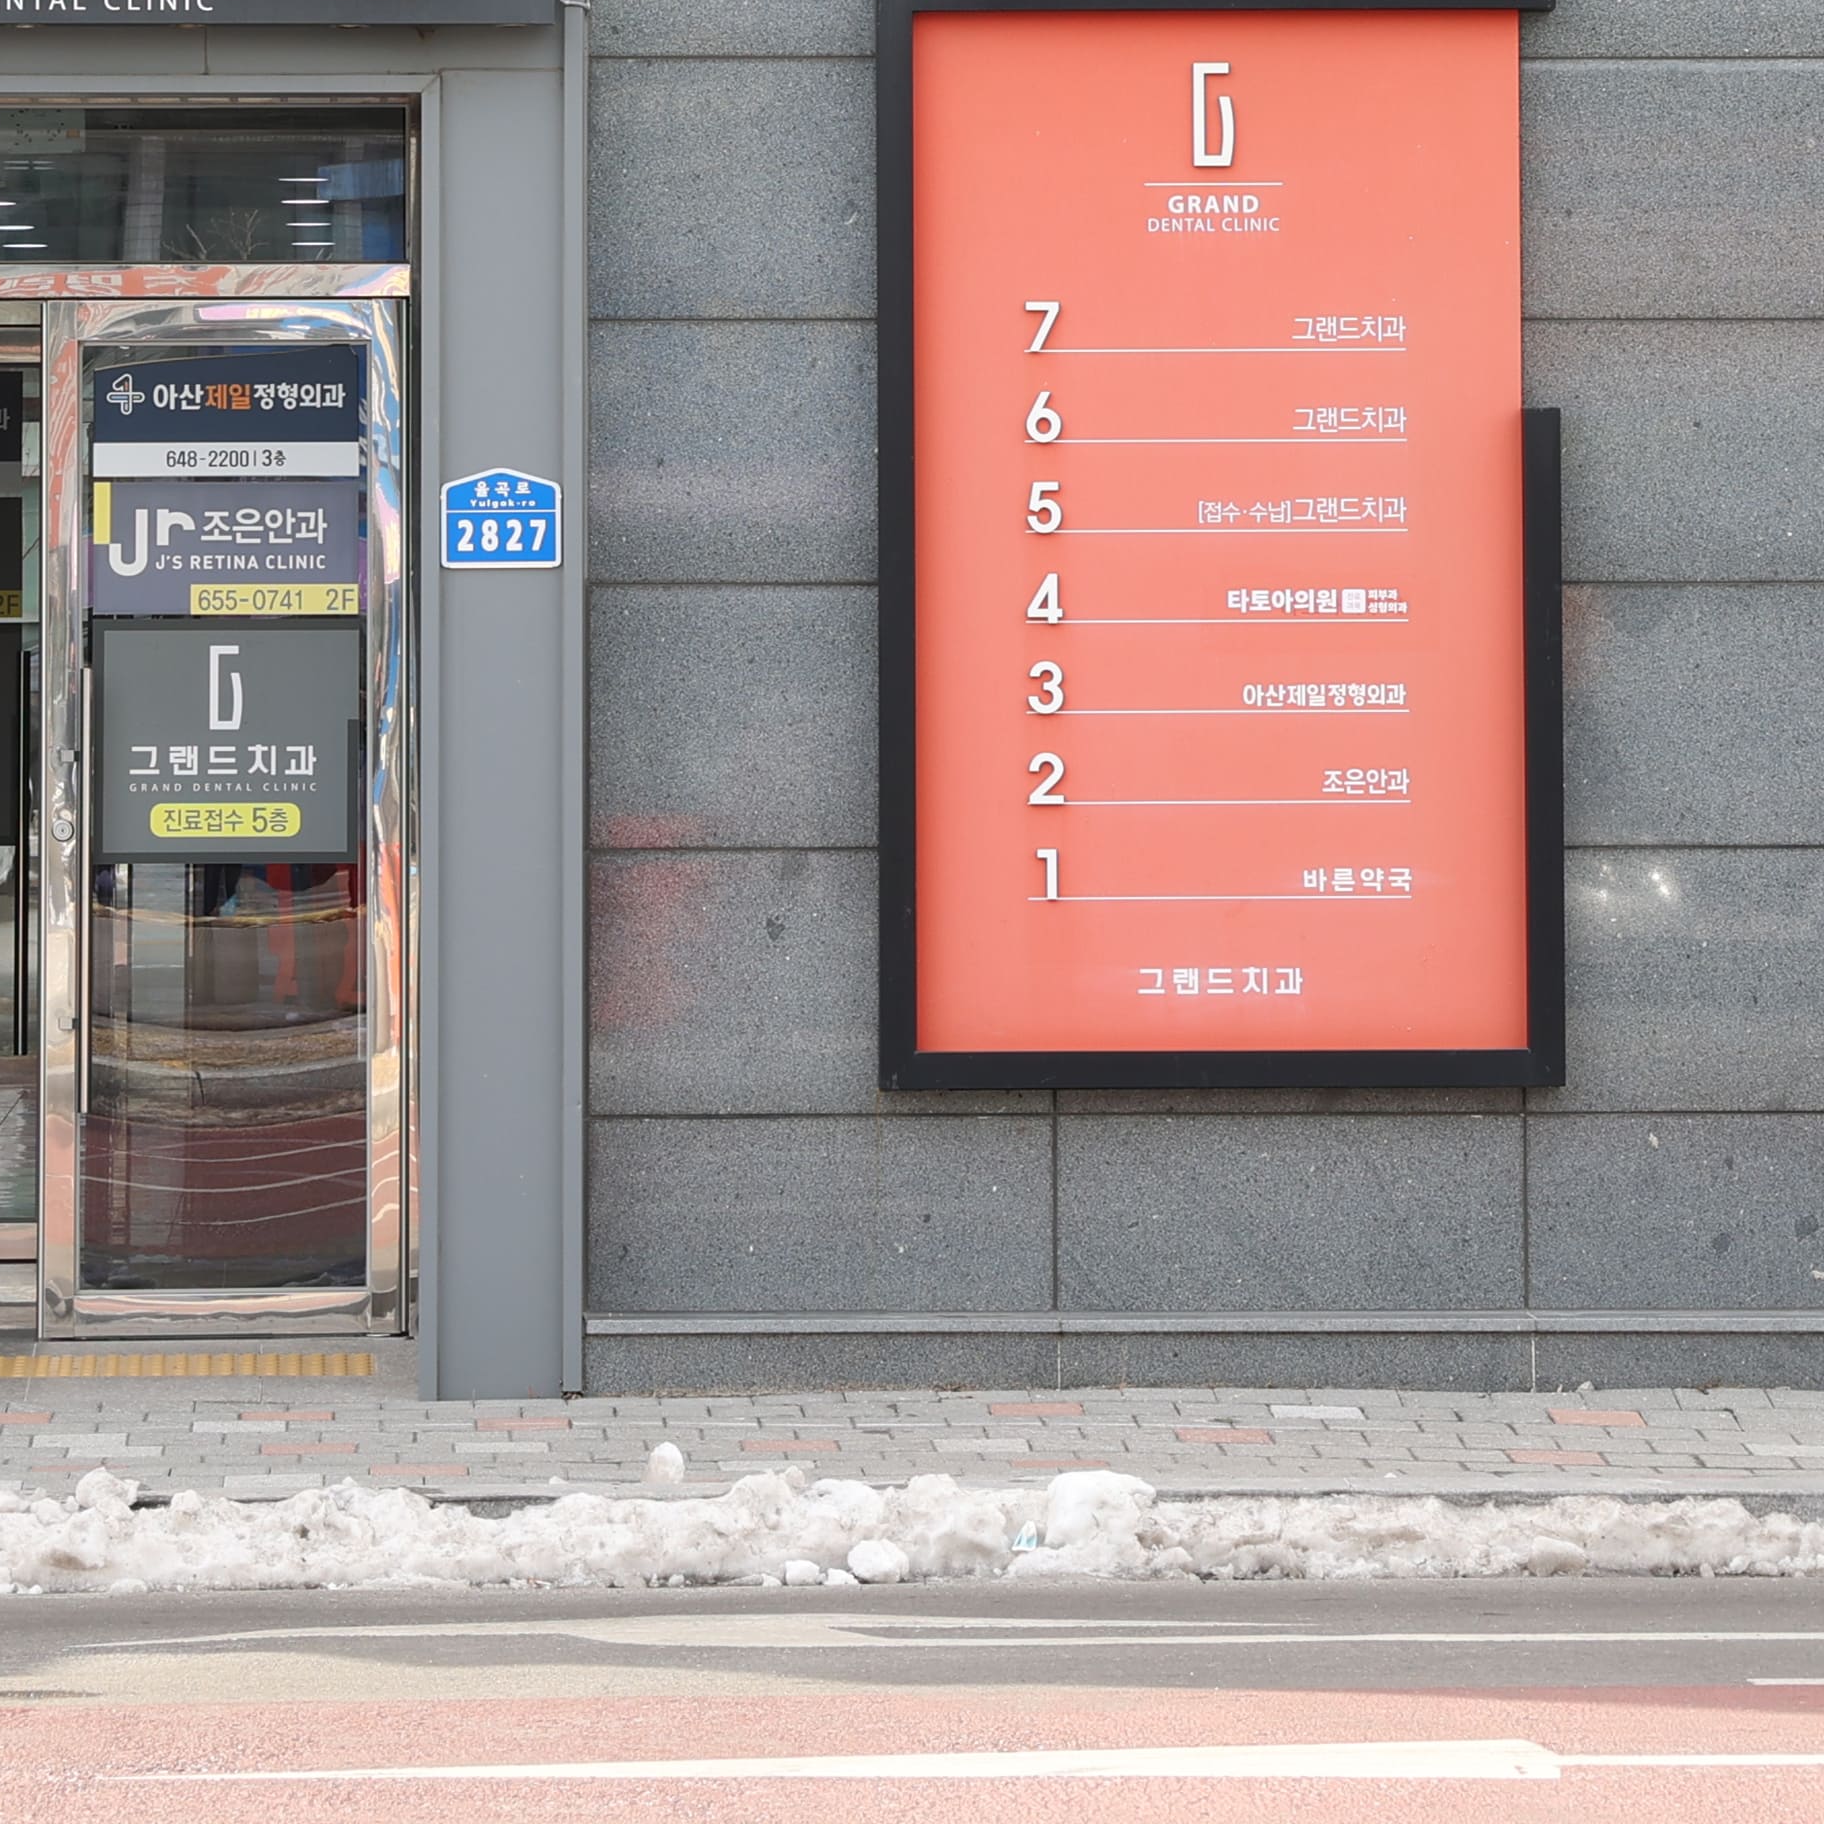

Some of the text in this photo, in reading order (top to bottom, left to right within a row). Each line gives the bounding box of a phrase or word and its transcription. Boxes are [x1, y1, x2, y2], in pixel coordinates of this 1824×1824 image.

[1167, 195, 1260, 214] GRAND
[1146, 217, 1280, 232] DENTAL CLINIC
[1024, 300, 1407, 353] 7 그랜드치과
[152, 382, 346, 411] 아산제일정형외과
[1025, 390, 1407, 443] 6 그랜드치과
[166, 449, 288, 469] 648-2200 3층
[473, 480, 532, 498] 율곡로
[1026, 480, 1063, 534] 5
[200, 507, 329, 545] 조은안과
[456, 518, 547, 552] 2827
[190, 553, 259, 570] RETINA
[265, 553, 327, 570] CLINIC
[197, 588, 356, 612] 655-0741 2F
[1026, 572, 1064, 625] 4
[1226, 588, 1338, 615] 타토아의원
[1027, 660, 1407, 715] 3 아산제일정형외과
[128, 744, 318, 777] 그랜드치과
[128, 782, 318, 793] GRAND DENTAL CLINIC
[1028, 751, 1410, 805] 2 조은안과
[163, 807, 289, 834] 진료접수 5층
[1035, 848, 1413, 900] 1 바른약국
[1137, 967, 1304, 996] 그랜드치과
